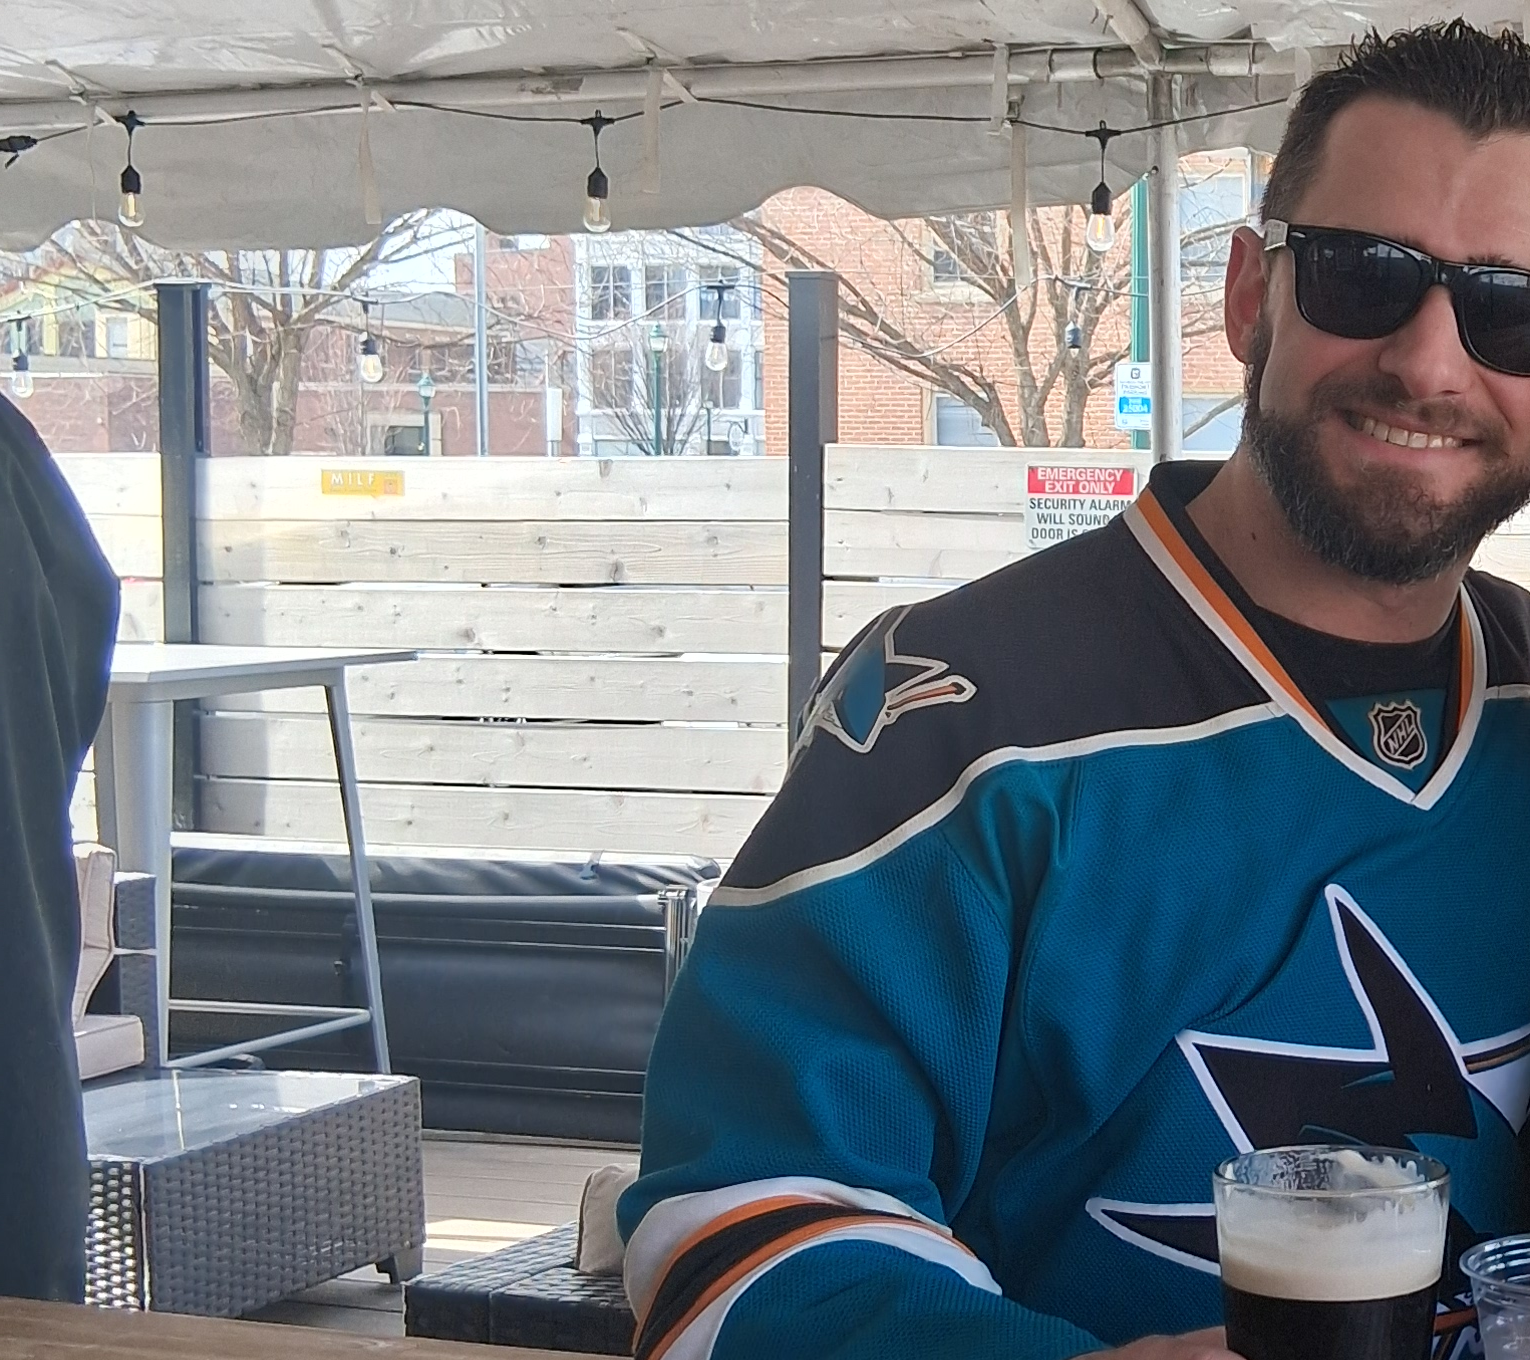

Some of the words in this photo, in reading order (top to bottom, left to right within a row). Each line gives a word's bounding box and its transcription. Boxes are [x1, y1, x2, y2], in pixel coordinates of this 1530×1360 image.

[331, 472, 375, 486] MILF
[1037, 467, 1123, 482] EMERGENCY
[1044, 481, 1076, 493] EXIT
[1078, 481, 1115, 495] ONLY
[1029, 497, 1086, 510] SECURITY
[1036, 512, 1065, 525] WILL
[1068, 513, 1110, 526] SOUND
[1031, 527, 1064, 540] DOOR
[1067, 528, 1079, 539] IS
[1387, 718, 1415, 754] NHL
